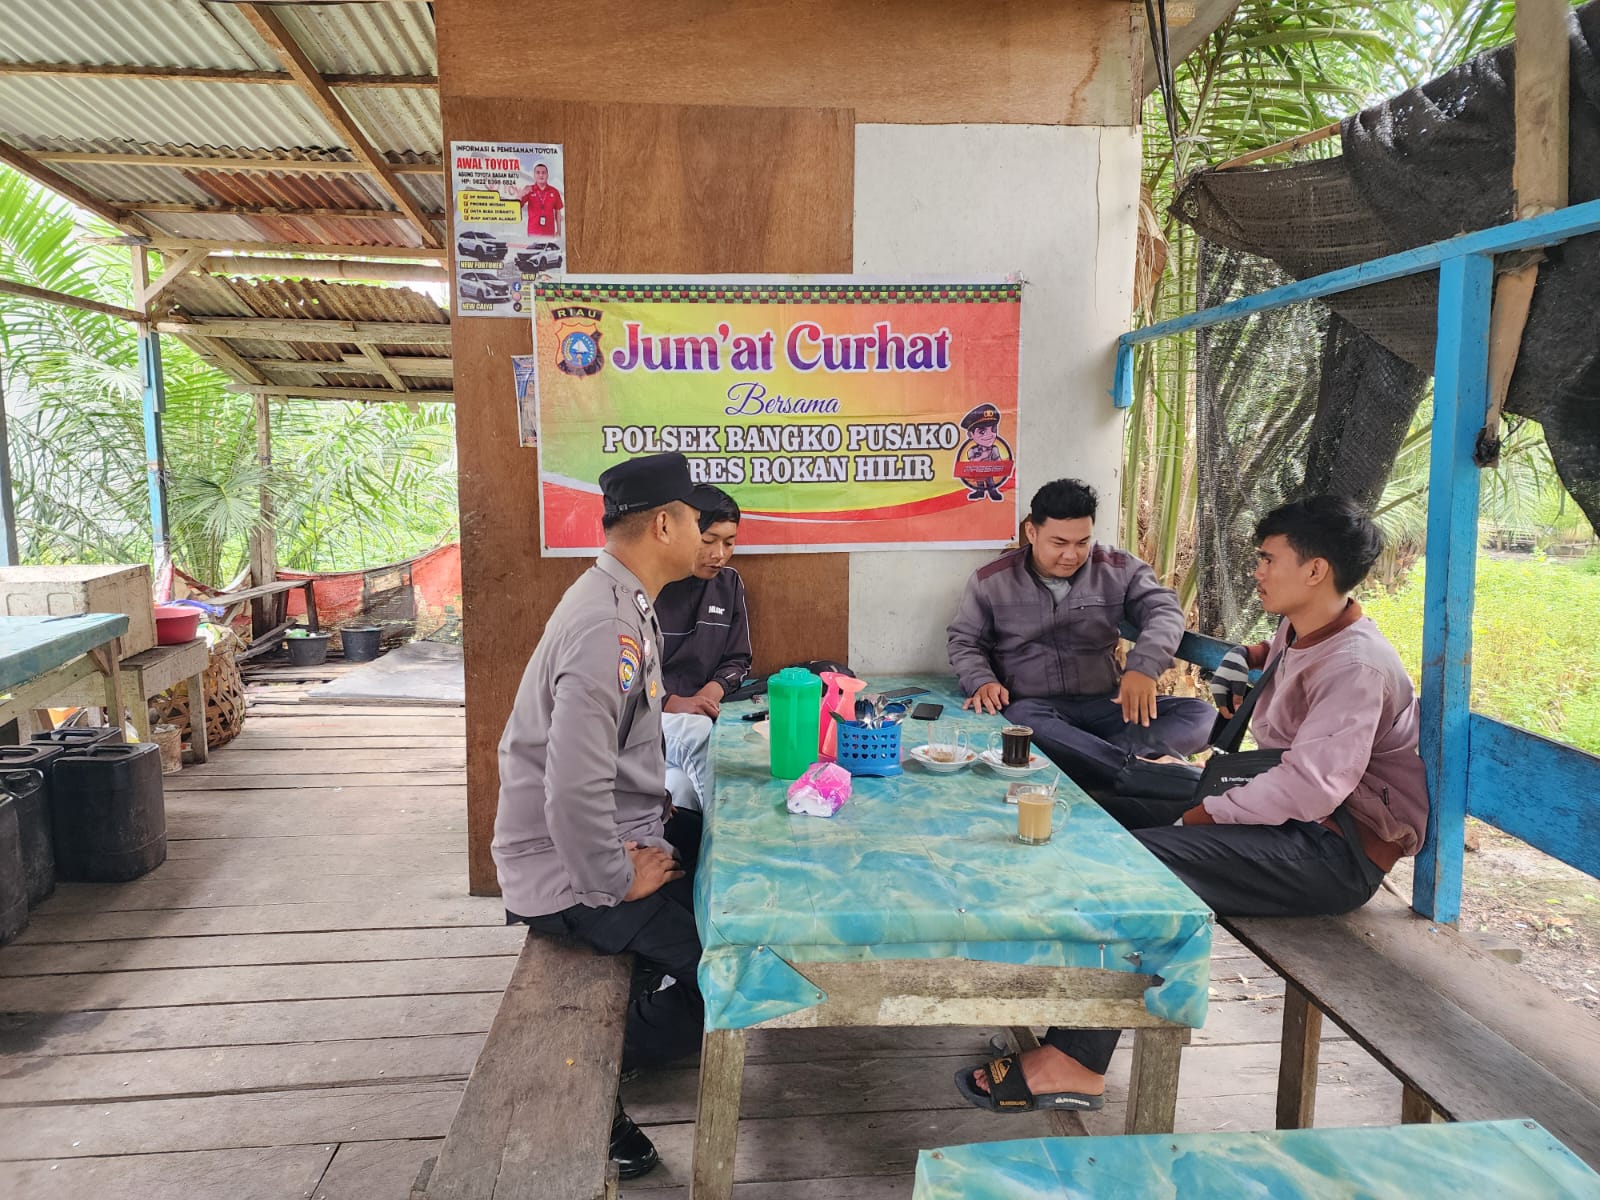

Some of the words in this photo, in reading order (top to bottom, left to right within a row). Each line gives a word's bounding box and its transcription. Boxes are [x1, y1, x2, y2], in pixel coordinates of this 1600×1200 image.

[456, 145, 490, 153] INFORMASI
[456, 157, 483, 169] AWAL
[485, 158, 520, 170] TOYOTA
[460, 261, 474, 269] NEW
[556, 308, 597, 318] RIAU
[612, 322, 774, 372] Jum'at
[787, 321, 950, 371] Curhat
[725, 382, 840, 416] Bersama
[603, 426, 720, 453] POLSEK
[726, 425, 841, 452] BANGKO
[847, 423, 960, 450] PUSAKO
[751, 455, 848, 483] ROKAN
[855, 453, 934, 481] HILIR
